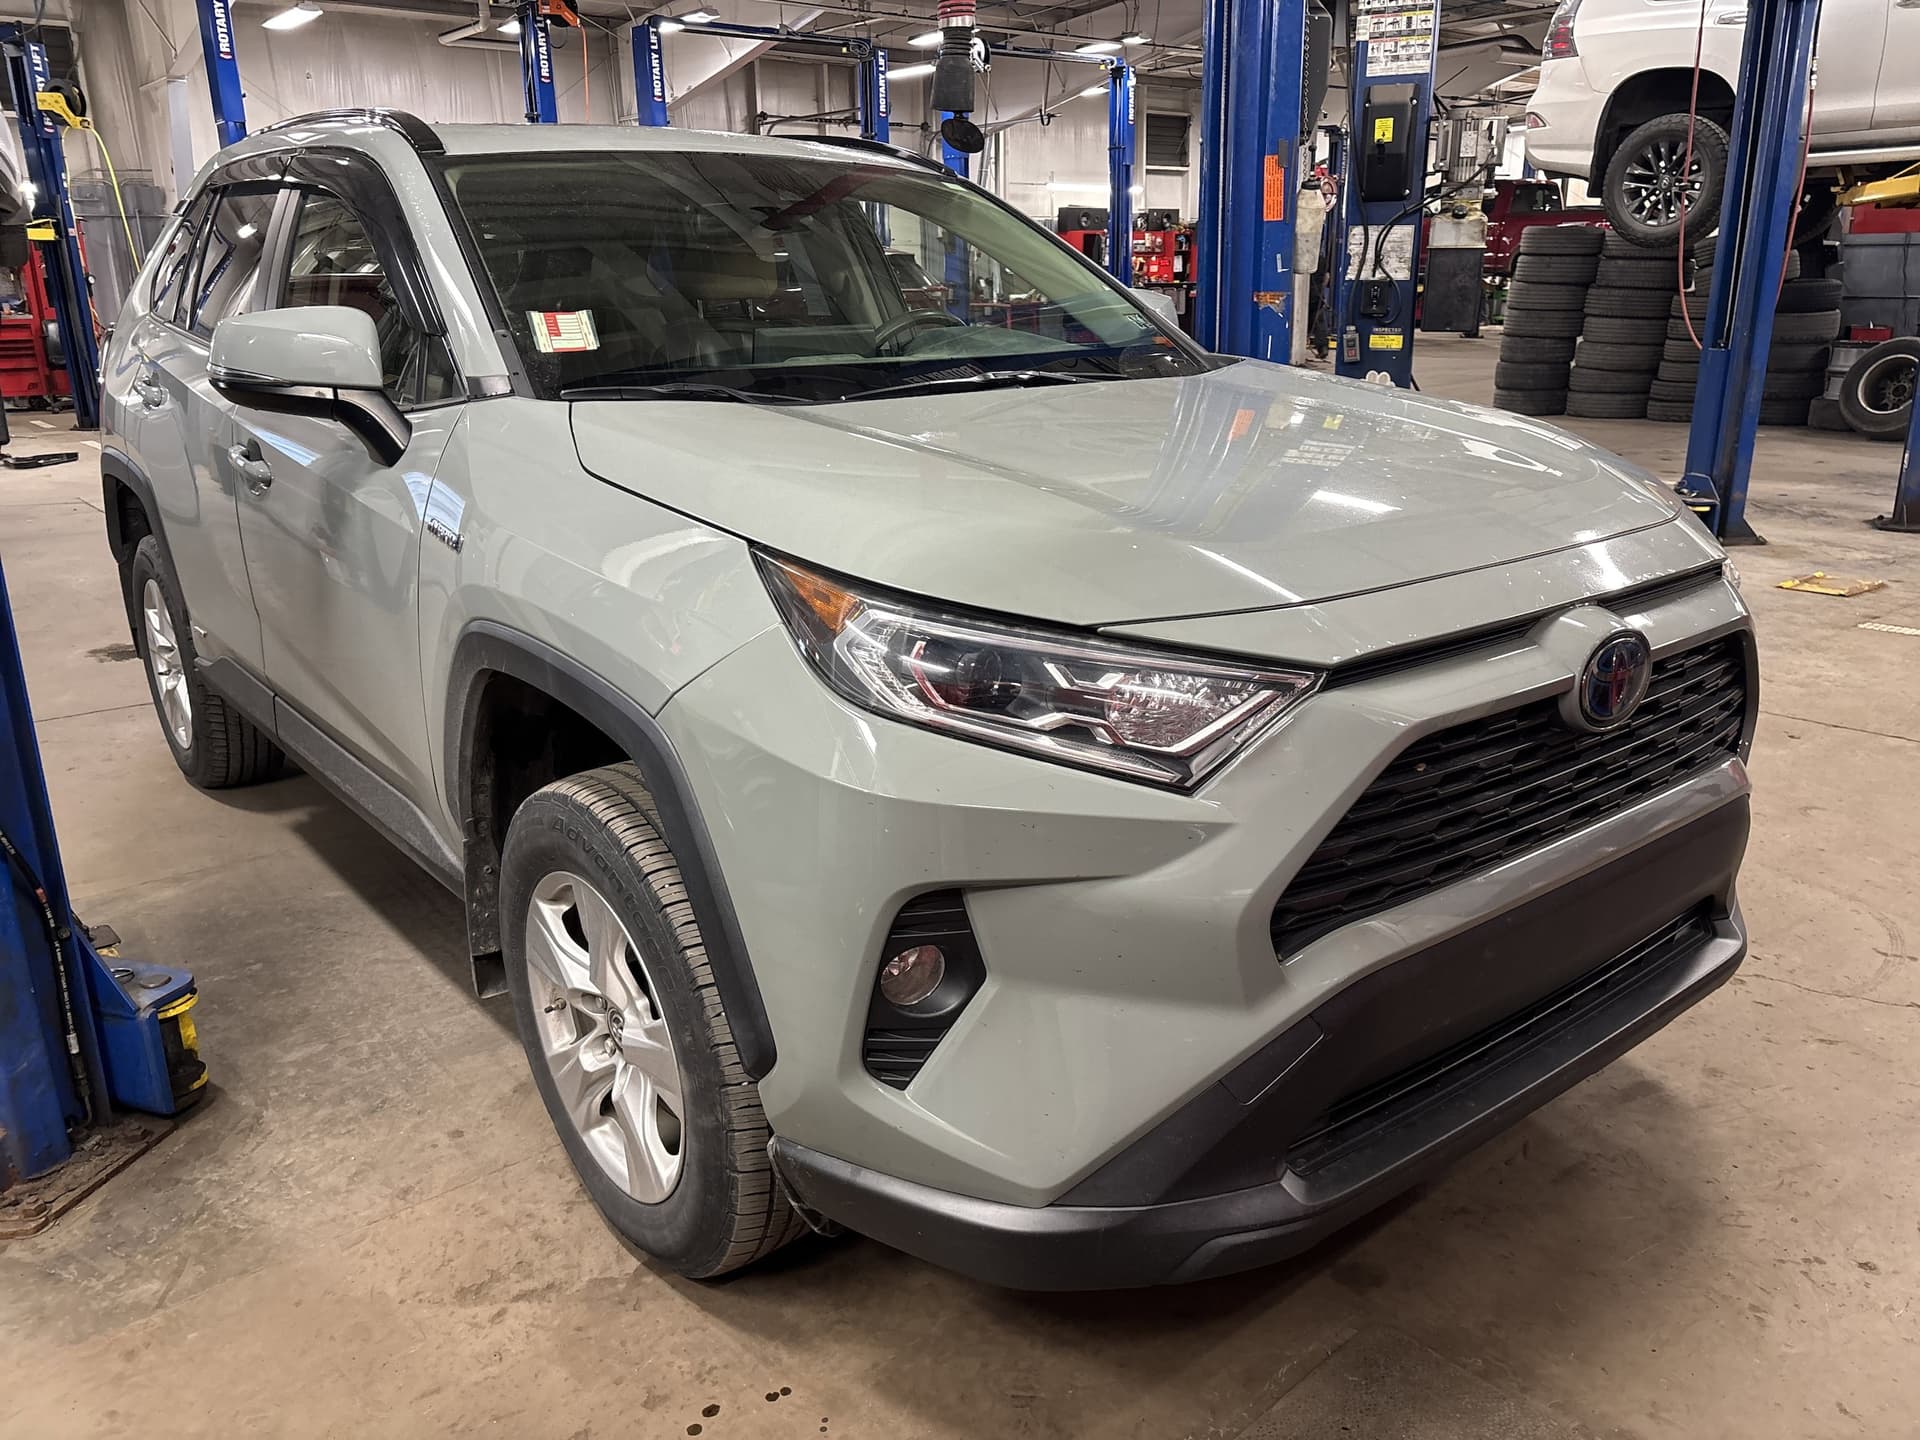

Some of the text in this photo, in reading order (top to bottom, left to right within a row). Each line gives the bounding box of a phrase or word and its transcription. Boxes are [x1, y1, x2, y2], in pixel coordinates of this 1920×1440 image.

[213, 0, 231, 52] ROTARY
[30, 44, 43, 72] LIFT
[537, 29, 550, 77] ROTARY
[649, 26, 662, 97] ROTARY LIFT
[878, 50, 887, 112] ROTARY LIFT
